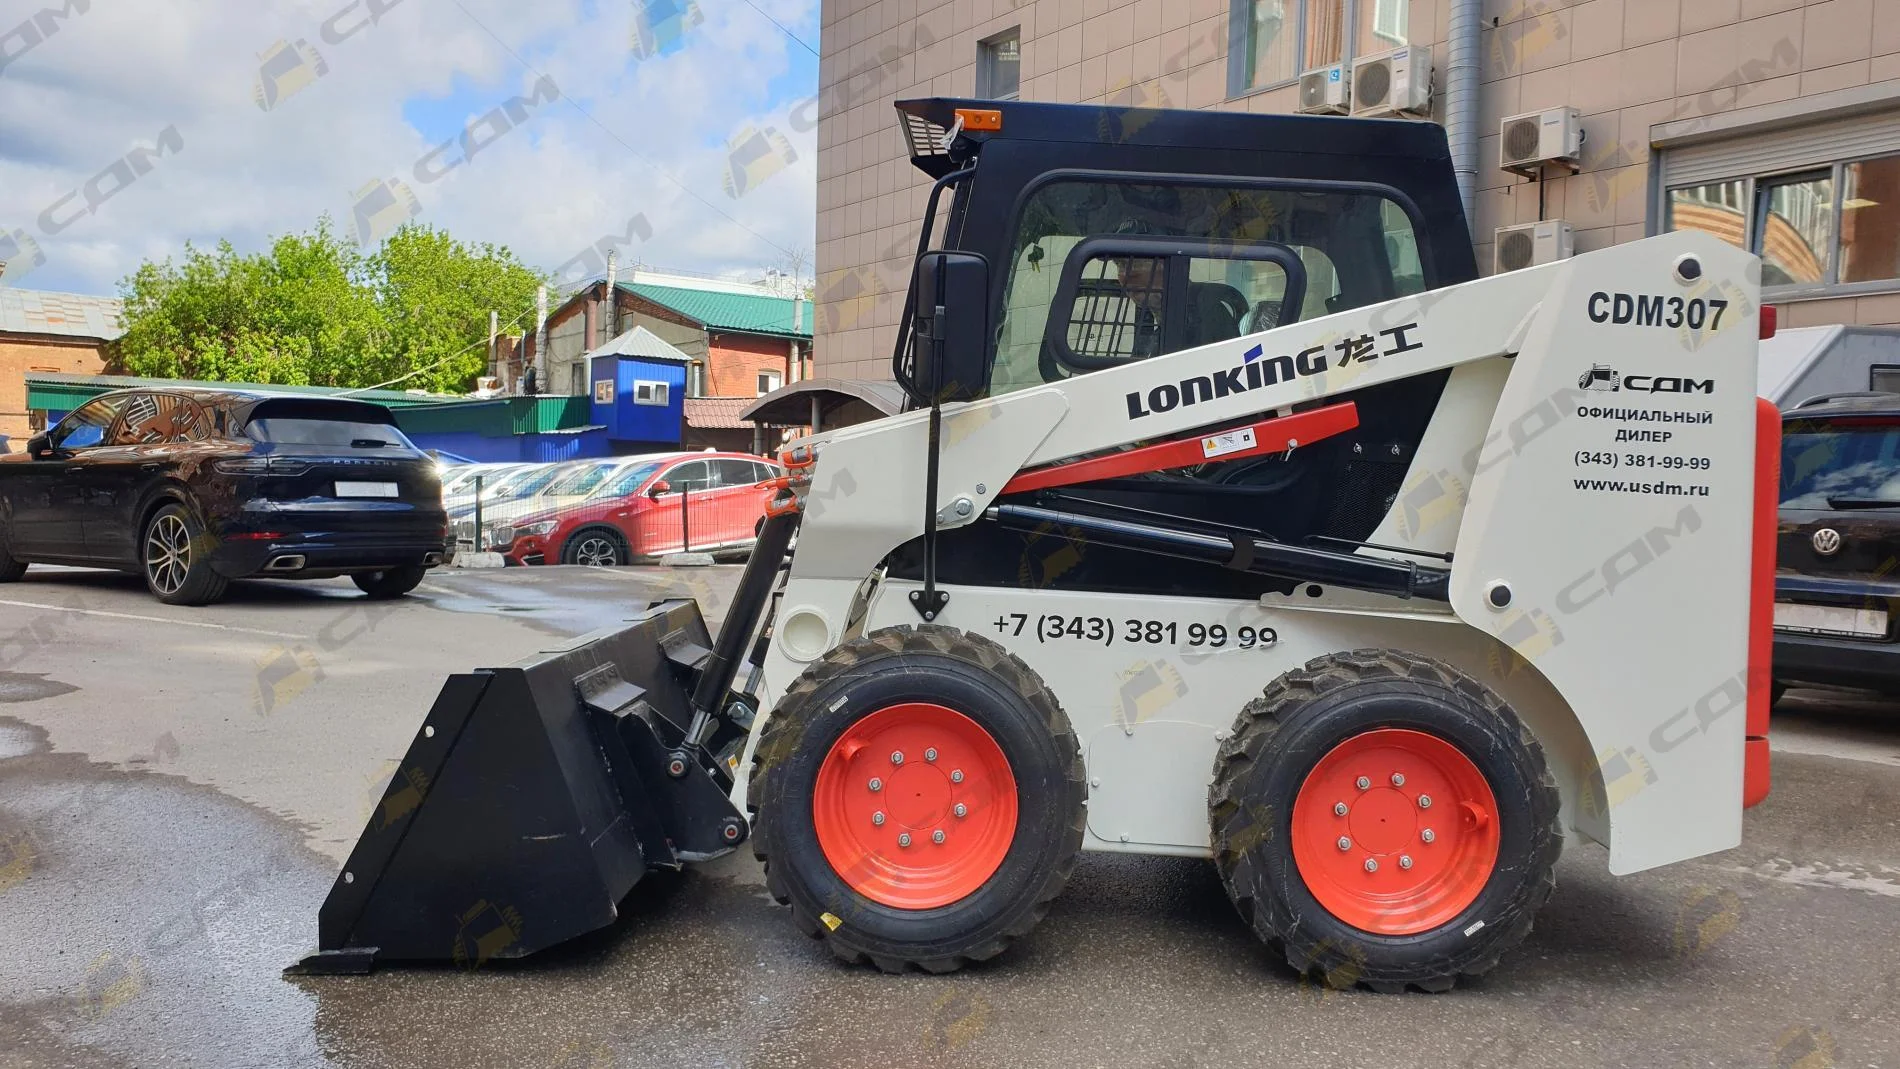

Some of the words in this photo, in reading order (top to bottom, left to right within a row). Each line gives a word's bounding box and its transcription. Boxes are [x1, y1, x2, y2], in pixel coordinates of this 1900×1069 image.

[1588, 292, 1729, 331] CDM307
[1335, 322, 1424, 368] 龙工
[1577, 406, 1713, 425] ОФИЦИАЛЬНЫЙ
[1615, 429, 1673, 443] ДИЛЕР
[1574, 451, 1619, 469] (343)
[1624, 454, 1711, 470] 381-99-99
[1574, 479, 1710, 497] www.usdm.ru
[993, 613, 1028, 637] +7
[1036, 614, 1115, 648] (343)
[1124, 619, 1177, 645] 381
[1187, 622, 1228, 648] 99
[1237, 626, 1279, 650] 99
